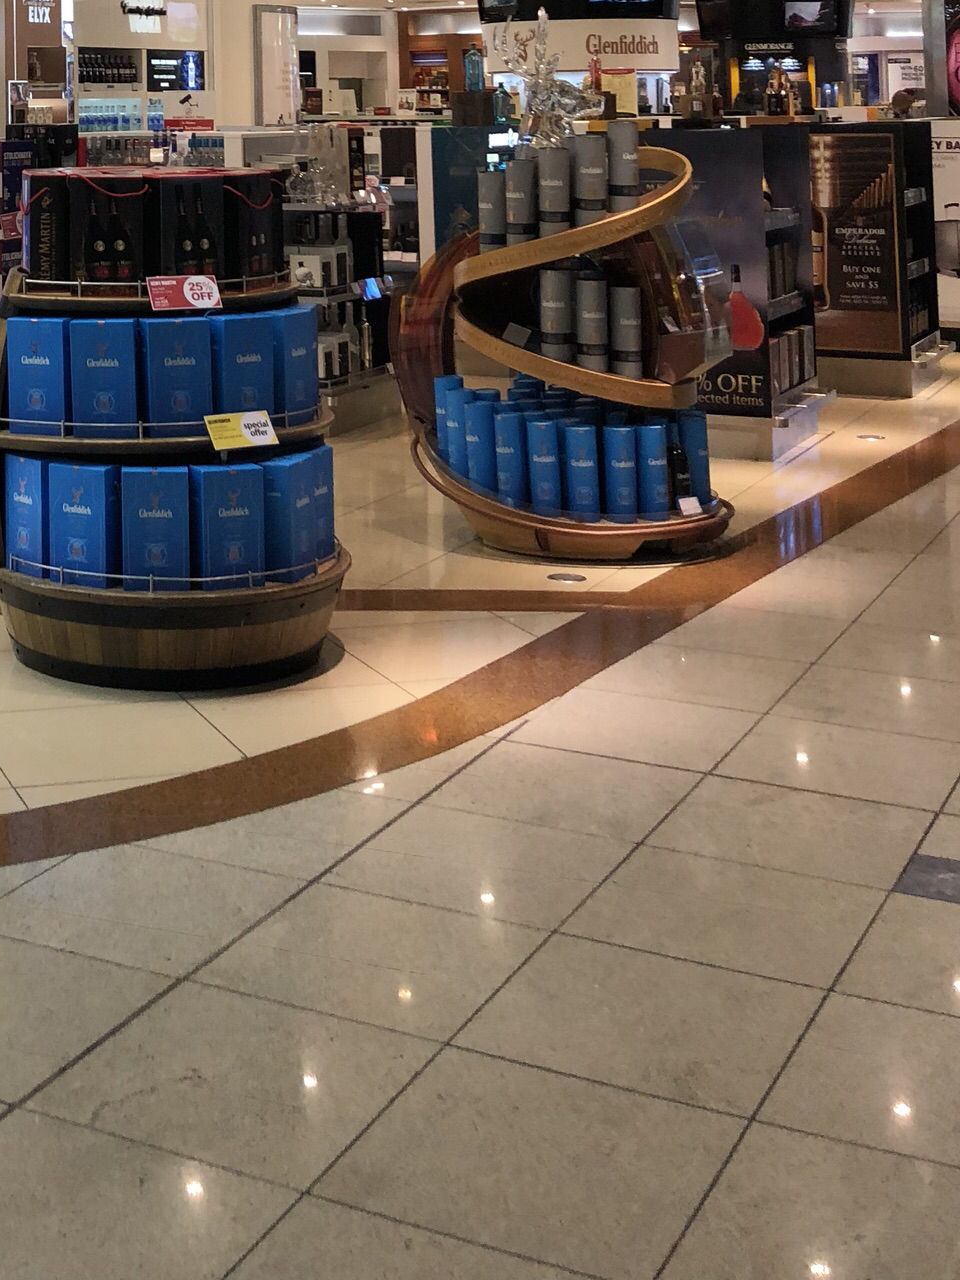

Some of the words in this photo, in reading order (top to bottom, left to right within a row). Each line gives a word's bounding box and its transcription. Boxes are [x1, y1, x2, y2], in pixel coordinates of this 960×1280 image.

[28, 5, 52, 23] ELYX
[585, 33, 659, 55] Glenfiddich
[38, 212, 51, 254] MARTIN
[835, 227, 886, 235] EMPERADOR
[842, 264, 860, 273] BUY
[861, 266, 881, 274] ONE
[188, 281, 214, 291] 25%
[845, 281, 866, 289] SAVE
[868, 281, 880, 289] $5
[191, 291, 214, 301] OFF
[21, 355, 50, 366] Glenfiddich
[86, 357, 119, 367] Glenfiddich
[717, 373, 764, 394] OFF
[697, 394, 729, 405] ected
[732, 394, 764, 407] items
[243, 419, 270, 430] special
[250, 429, 268, 437] offer
[62, 503, 92, 515] Glenfiddich
[139, 508, 173, 518] Glenfiddich
